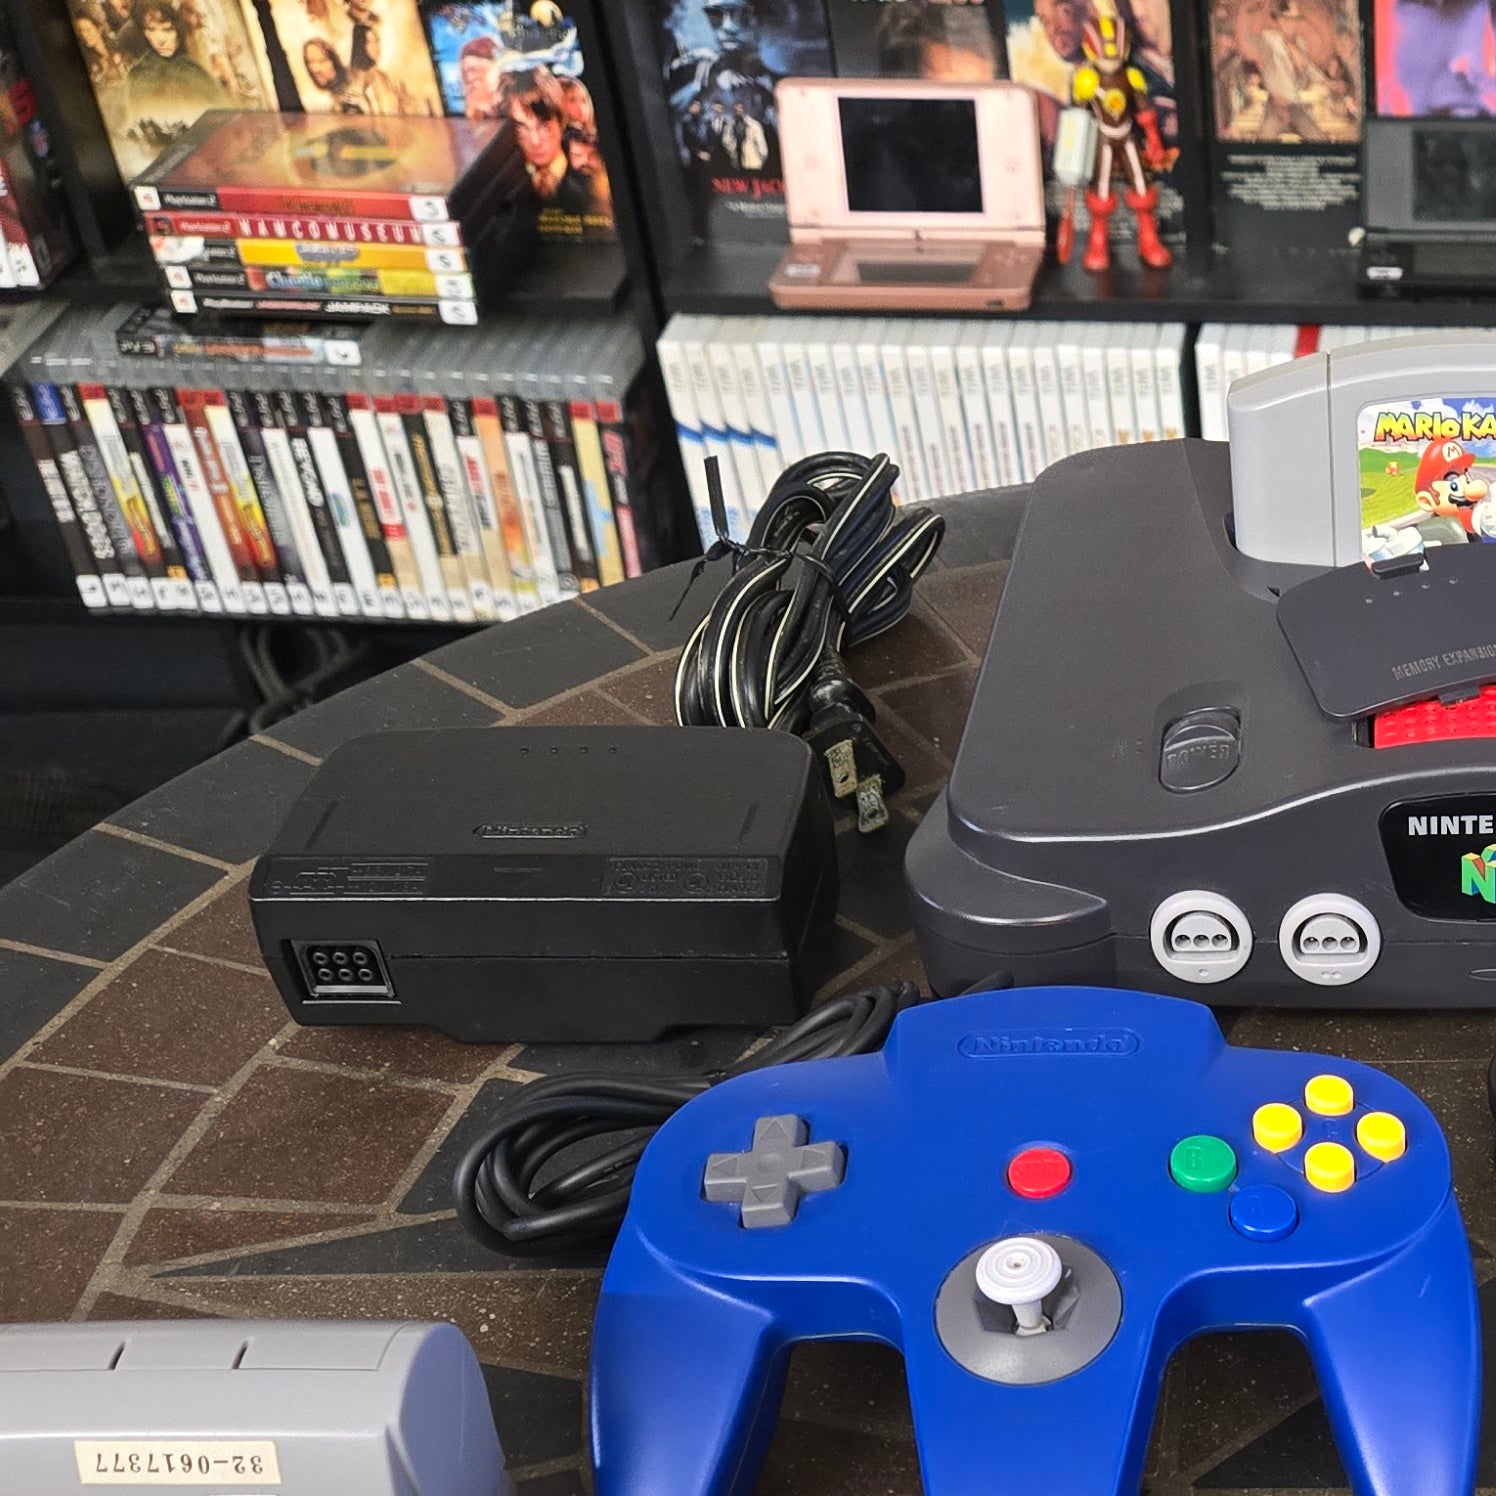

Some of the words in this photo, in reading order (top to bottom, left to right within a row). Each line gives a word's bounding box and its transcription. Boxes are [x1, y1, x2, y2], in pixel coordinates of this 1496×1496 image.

[1374, 411, 1462, 442] MARIO
[1391, 655, 1441, 680] MEMORY
[972, 1034, 1124, 1053] Nintendo
[96, 1453, 264, 1475] 32-0617377
